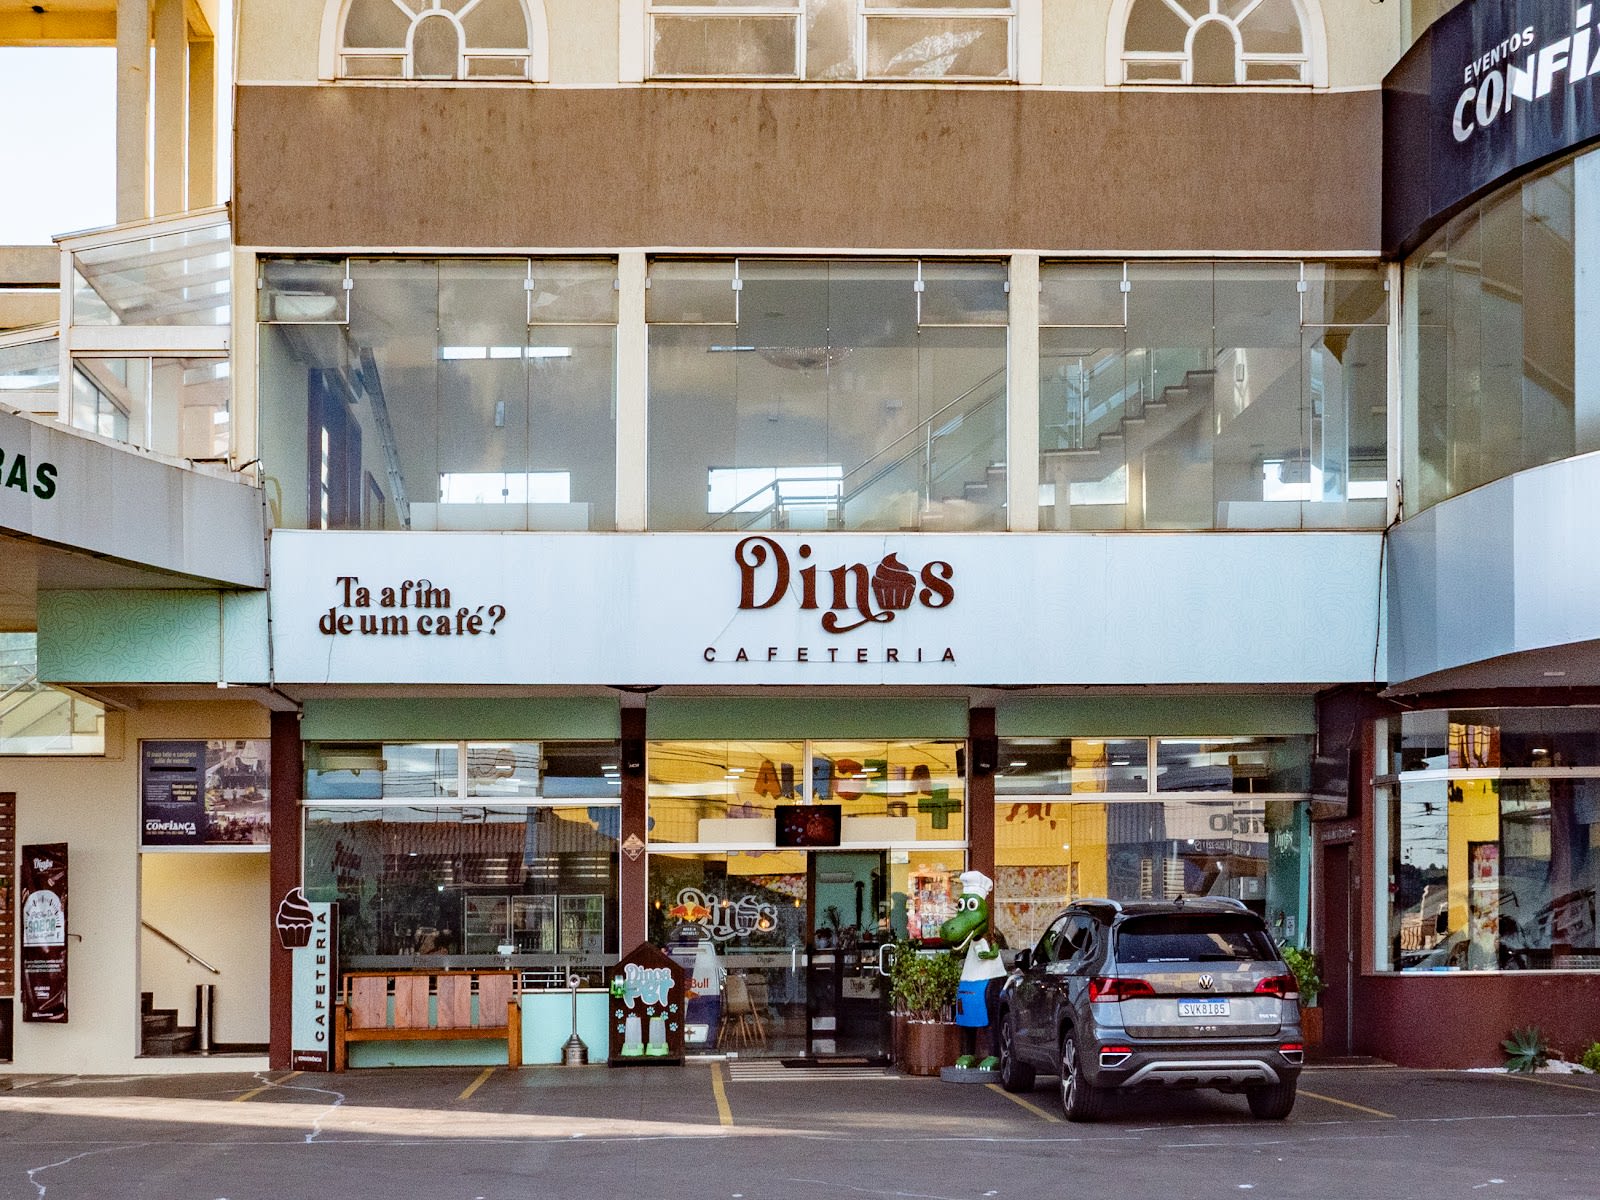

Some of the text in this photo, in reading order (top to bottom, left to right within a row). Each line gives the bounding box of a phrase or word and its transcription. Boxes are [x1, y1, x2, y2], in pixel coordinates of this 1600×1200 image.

[1464, 26, 1534, 84] EVENTOS
[0, 447, 58, 499] AS
[336, 576, 370, 608] Ta
[319, 604, 506, 635] de um café?
[703, 647, 955, 662] CAFETERIA
[315, 901, 327, 1043] CAFETERIA
[624, 963, 671, 983] Dinos
